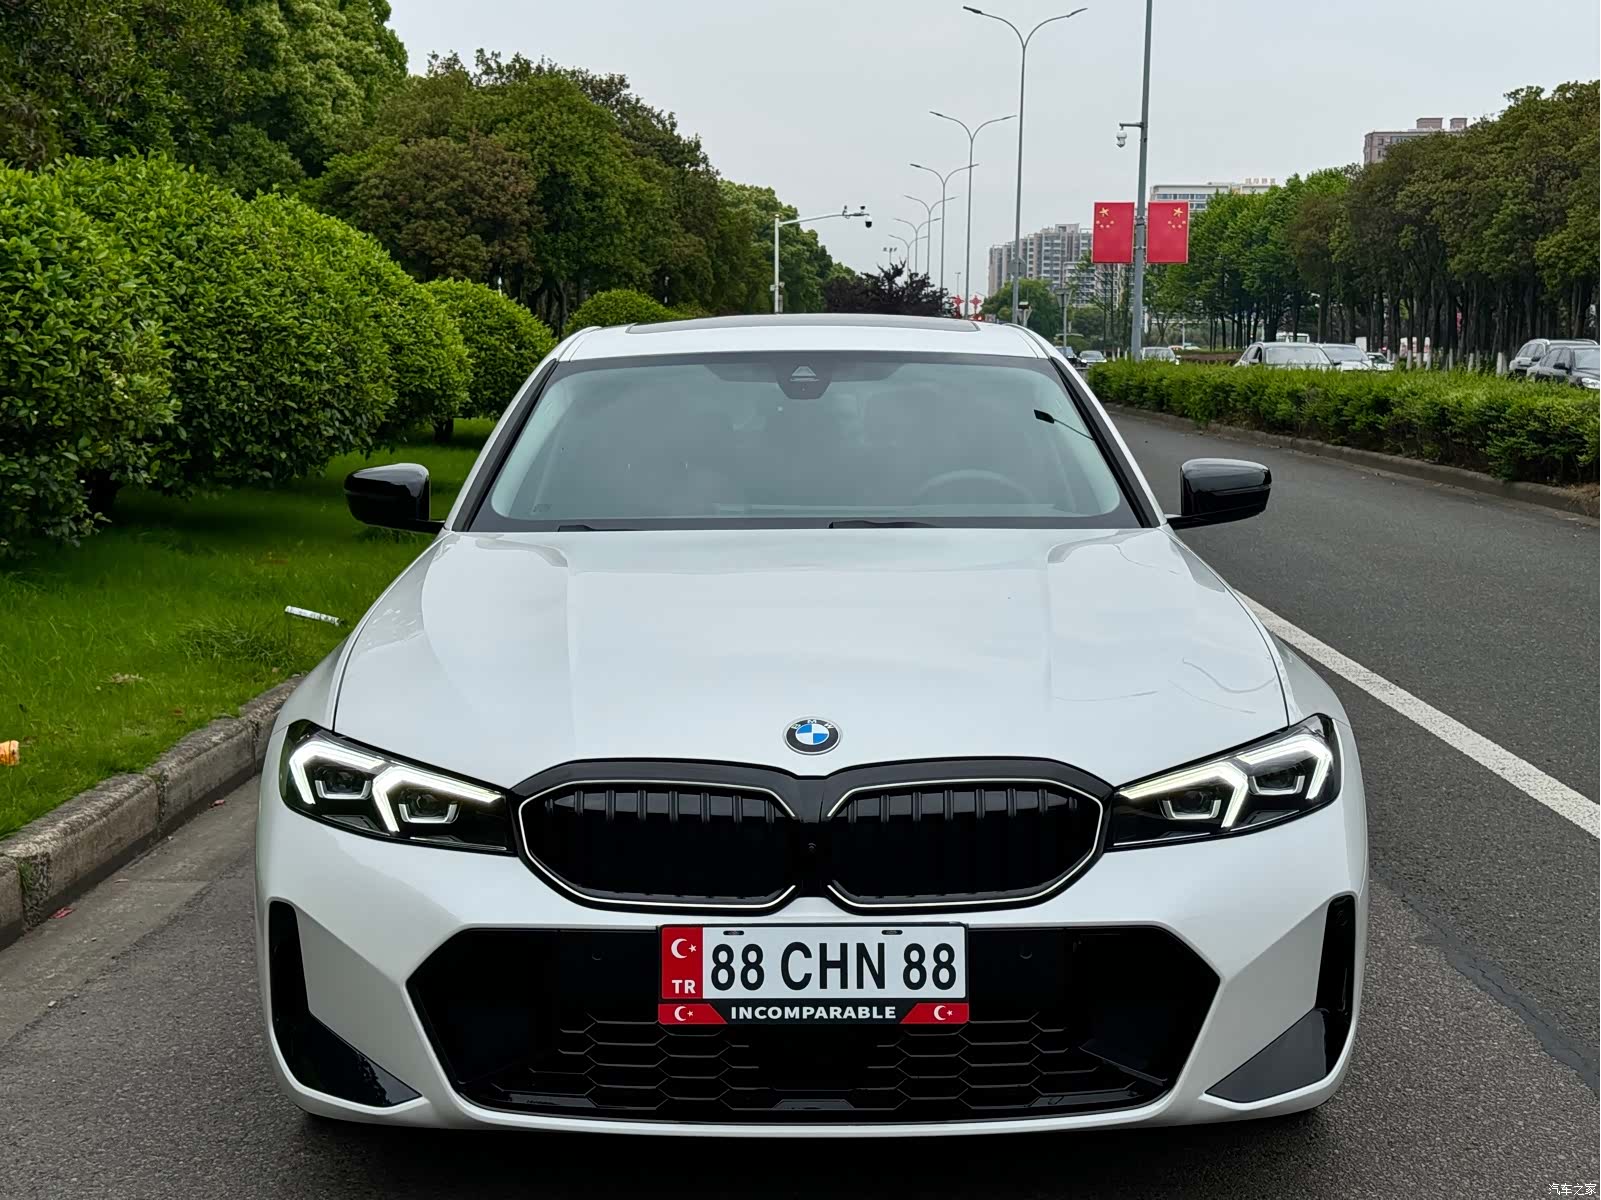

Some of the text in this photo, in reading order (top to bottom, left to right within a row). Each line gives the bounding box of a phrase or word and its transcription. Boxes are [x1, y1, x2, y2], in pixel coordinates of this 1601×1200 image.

[711, 941, 957, 991] 88 CHN 88
[671, 979, 696, 994] TR
[731, 1006, 896, 1020] INCOMPARABLE
